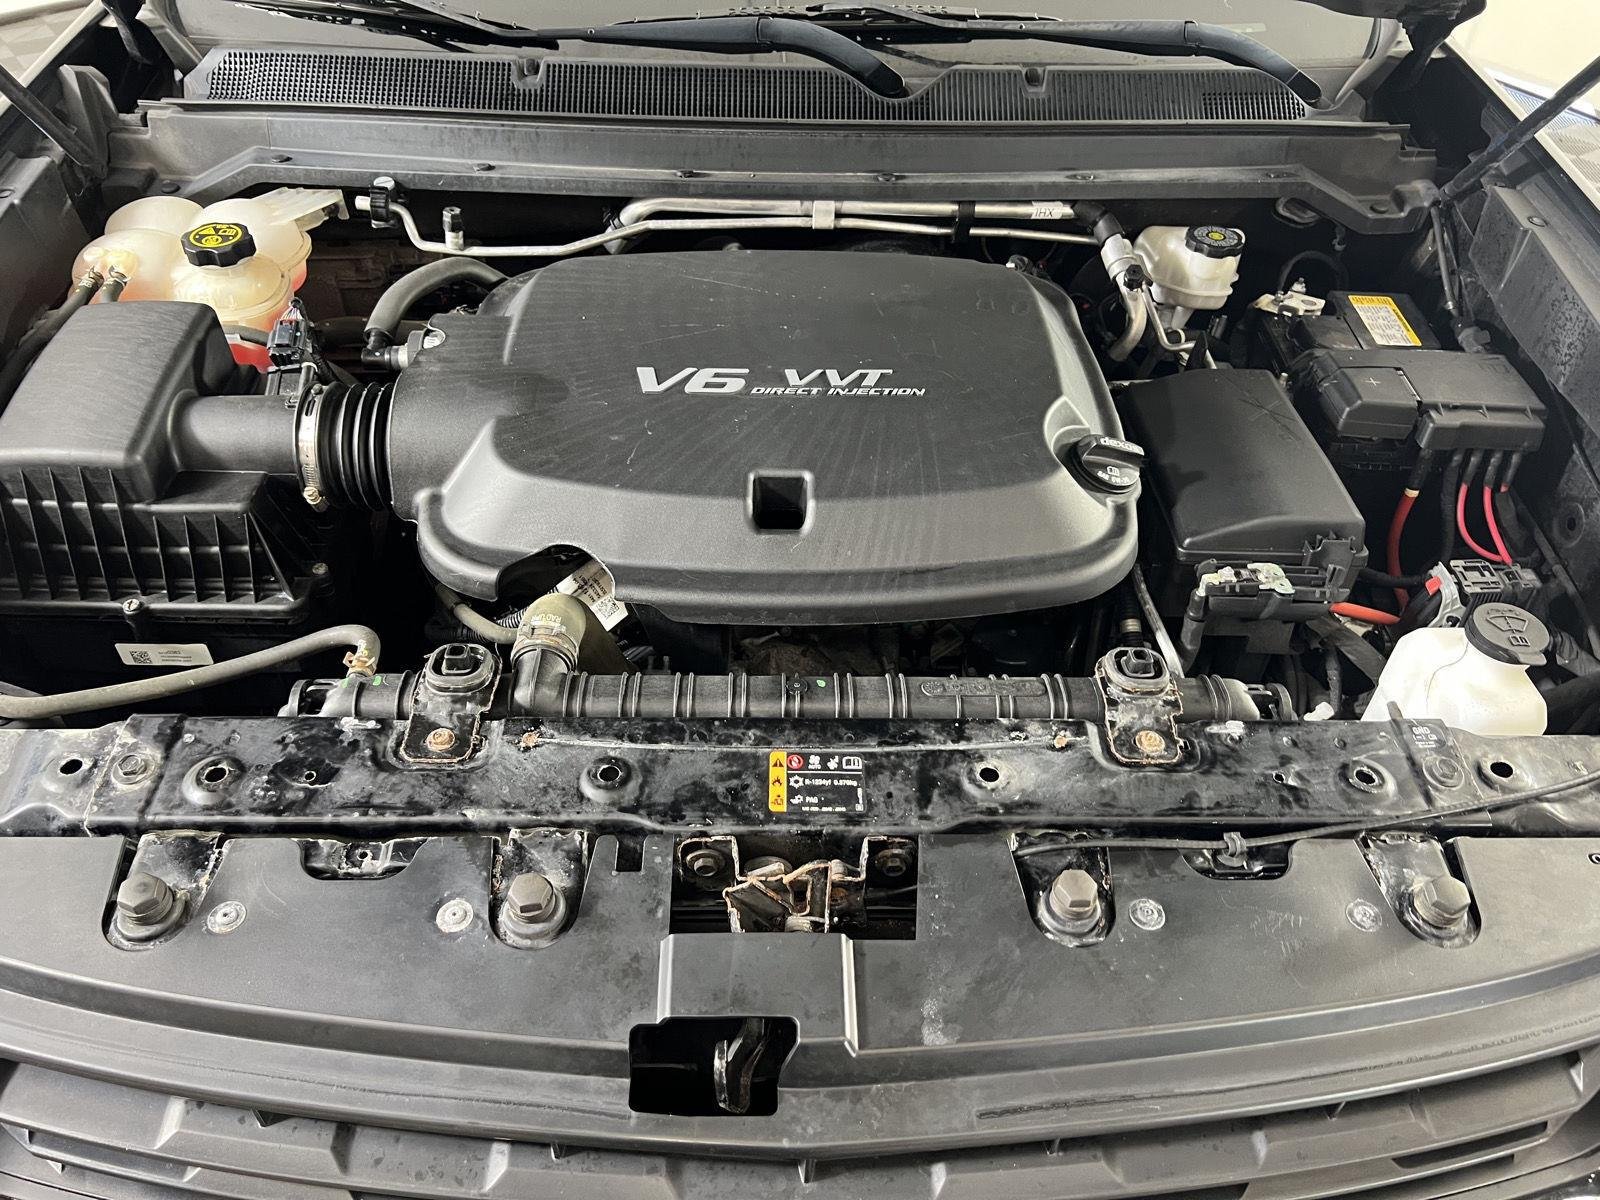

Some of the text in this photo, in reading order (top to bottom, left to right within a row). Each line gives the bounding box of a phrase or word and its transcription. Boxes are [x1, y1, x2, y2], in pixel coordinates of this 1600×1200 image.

[636, 366, 749, 394] V6
[784, 368, 893, 386] VVT
[750, 387, 926, 397] DIRECT INJECTION
